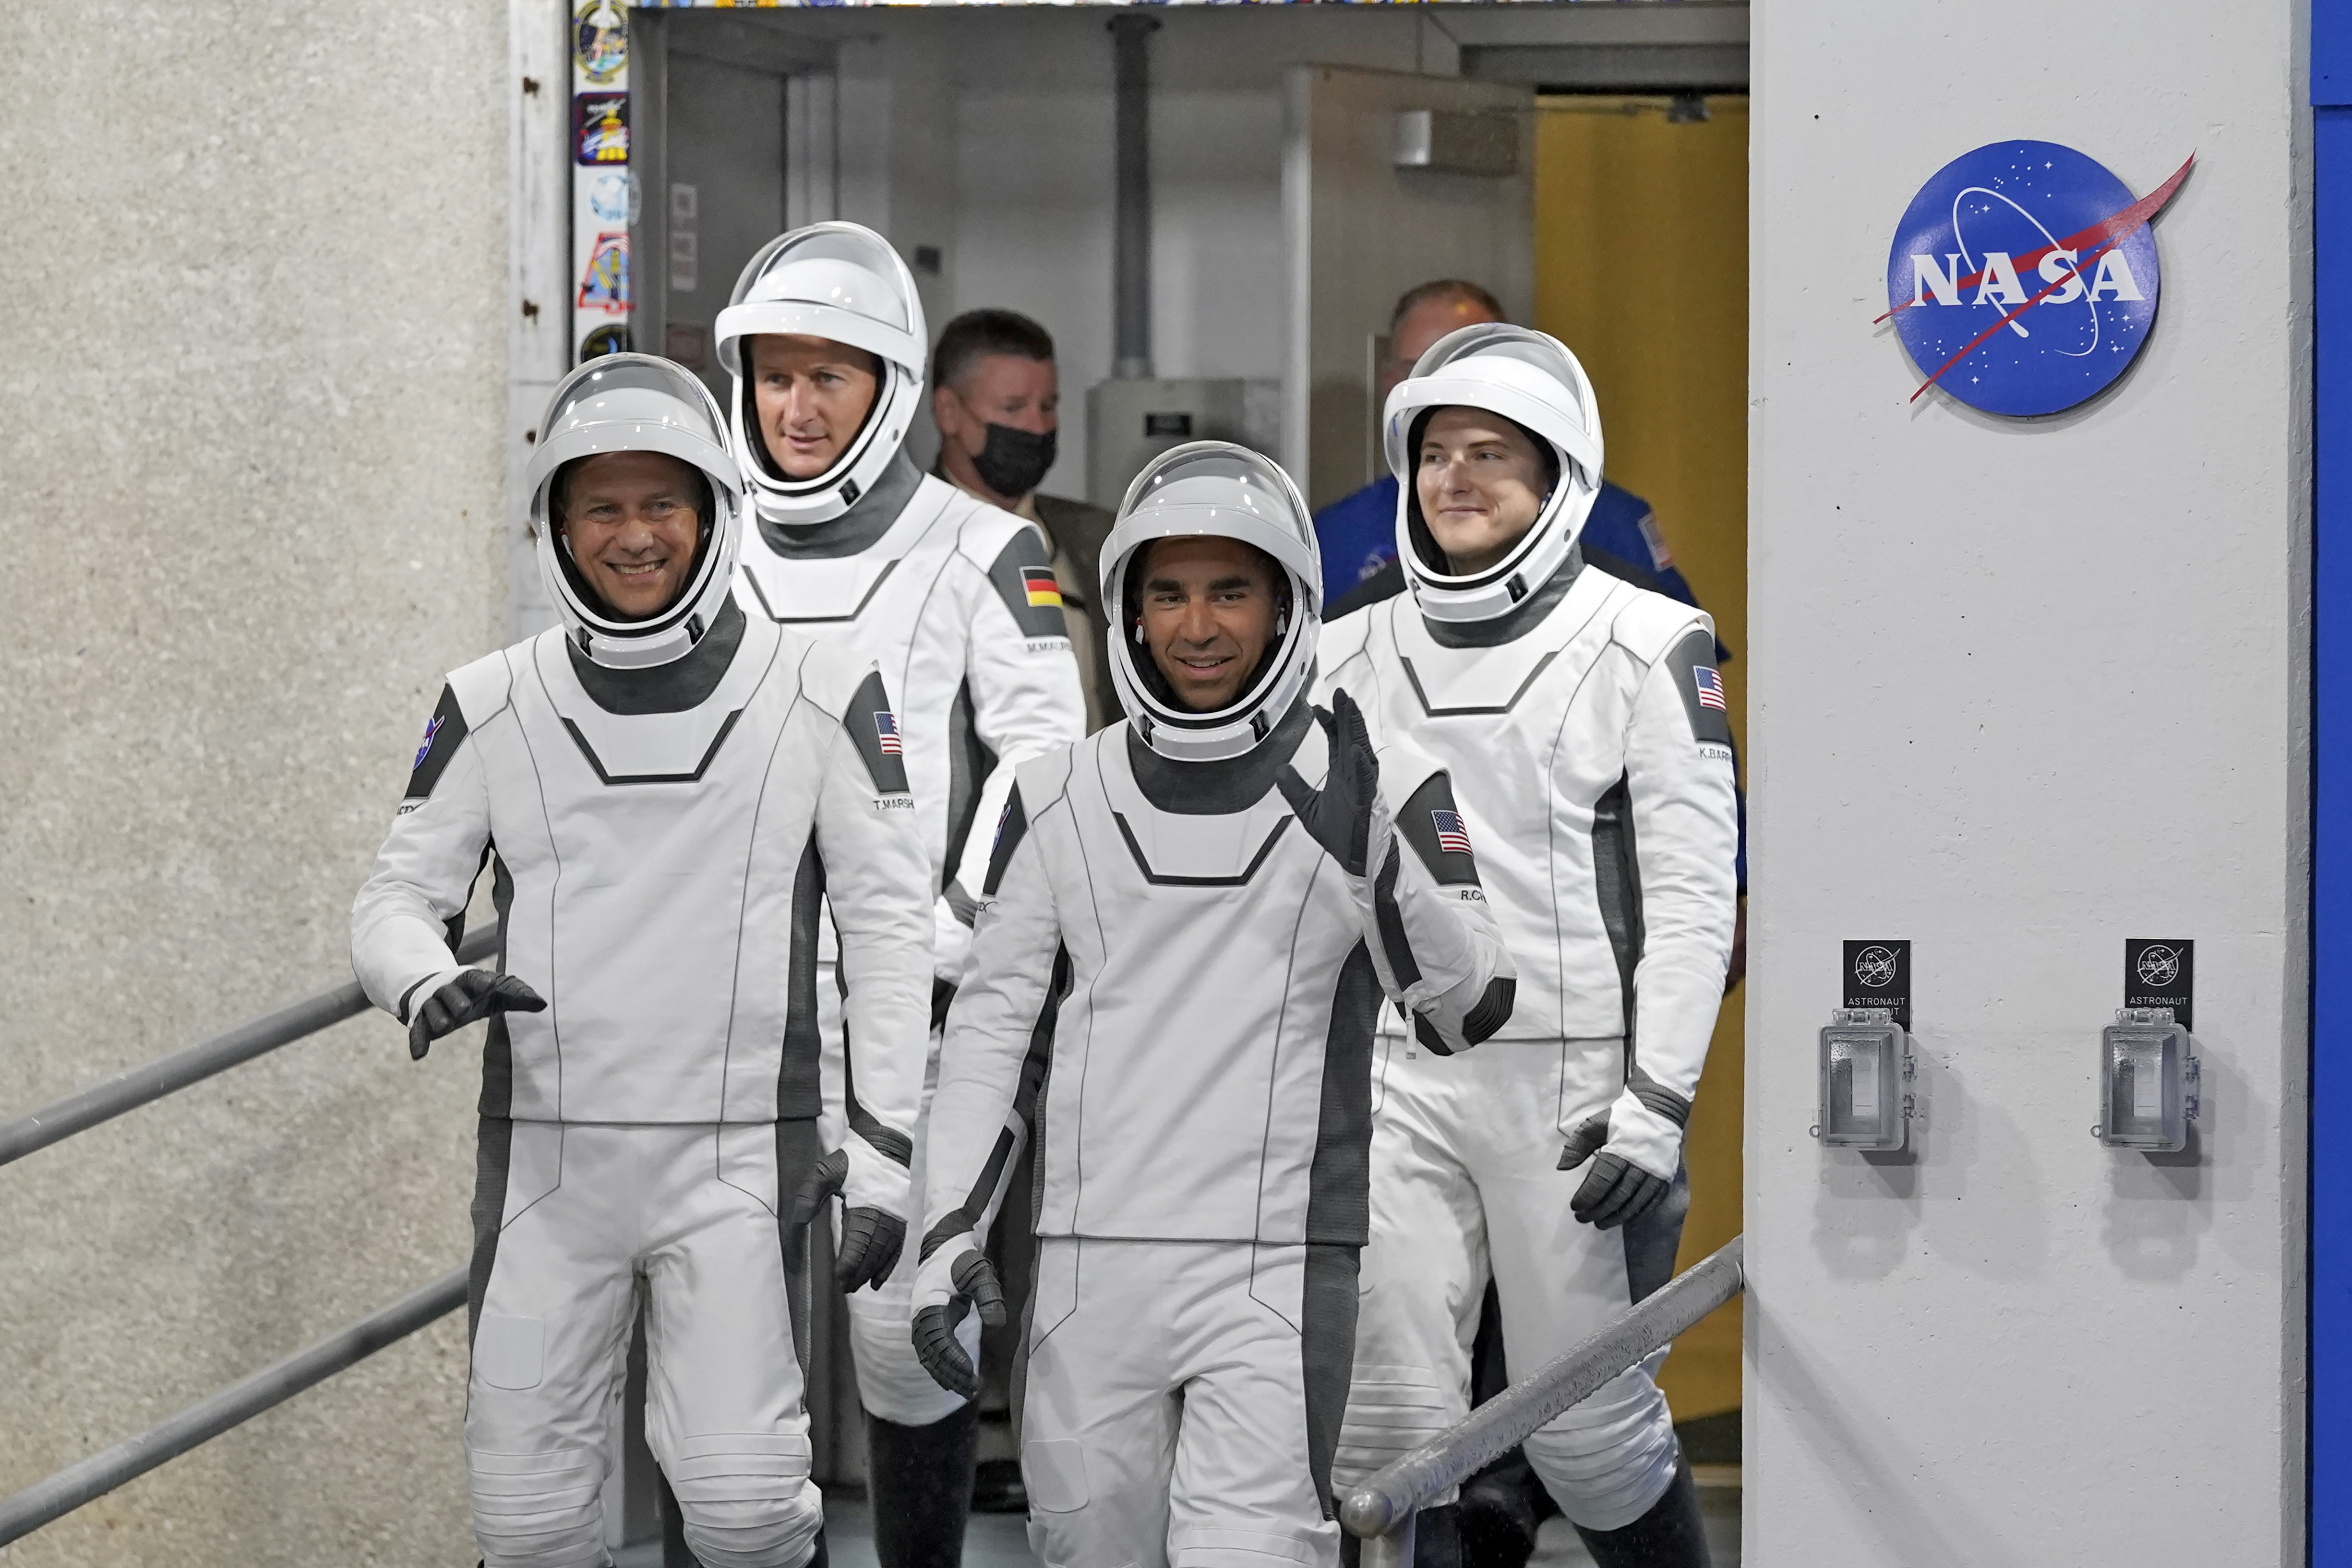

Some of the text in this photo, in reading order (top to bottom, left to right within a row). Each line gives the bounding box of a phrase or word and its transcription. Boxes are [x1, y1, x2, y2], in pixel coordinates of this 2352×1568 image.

[1909, 248, 2145, 307] NASA
[1848, 997, 1905, 1005] ASTRONAUT
[2129, 996, 2187, 1005] ASTRONAUT
